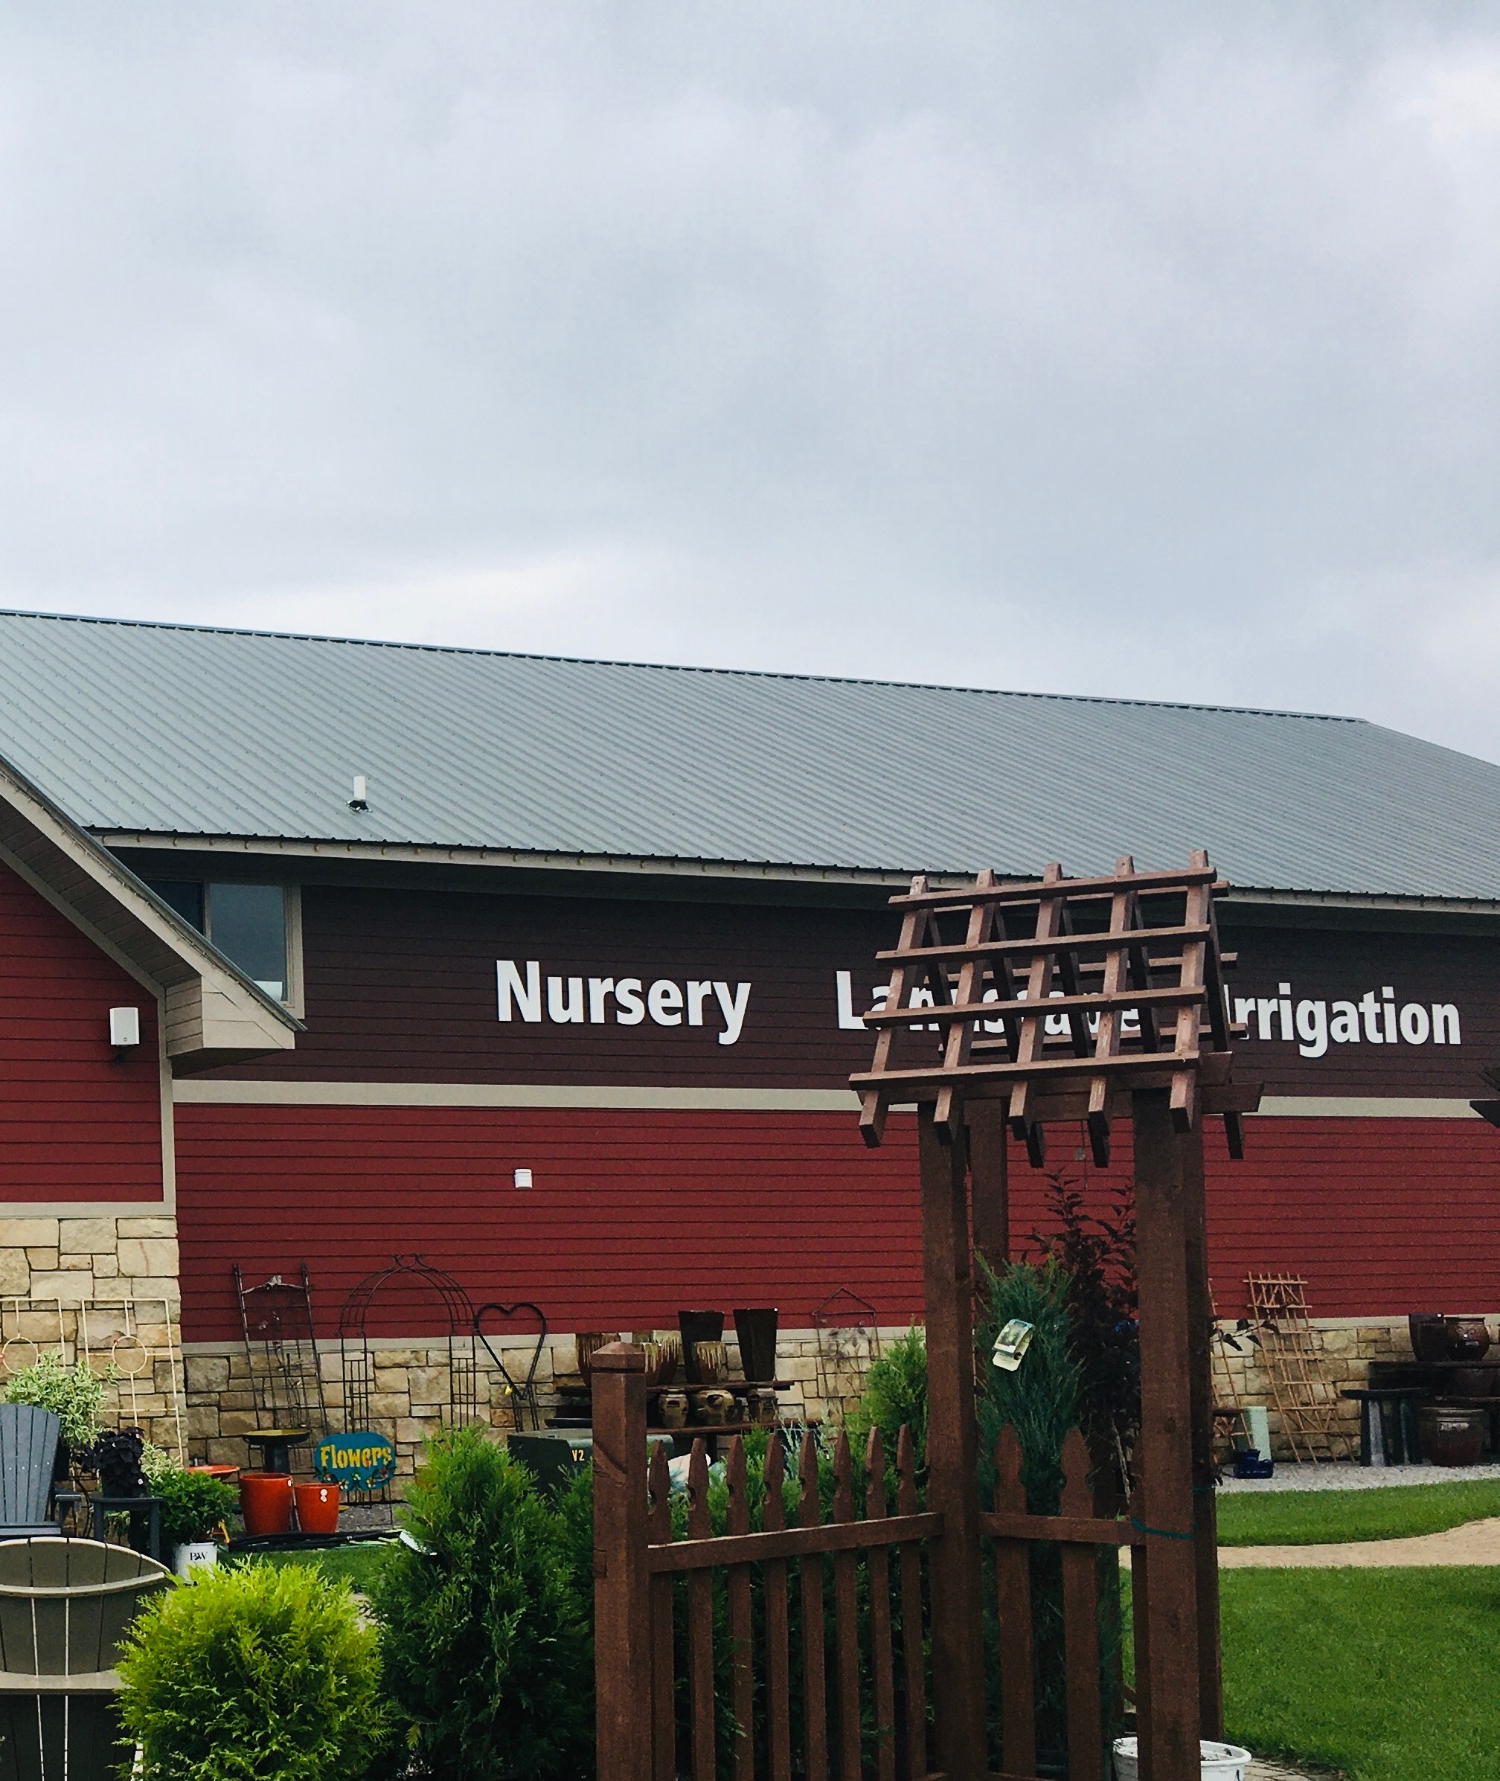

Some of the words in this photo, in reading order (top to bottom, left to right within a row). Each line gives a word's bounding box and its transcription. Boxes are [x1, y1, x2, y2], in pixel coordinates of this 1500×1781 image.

[496, 959, 752, 1045] Nursery
[836, 970, 1142, 1035] Lansae
[320, 1444, 393, 1469] Flowers
[571, 1449, 585, 1462] V2
